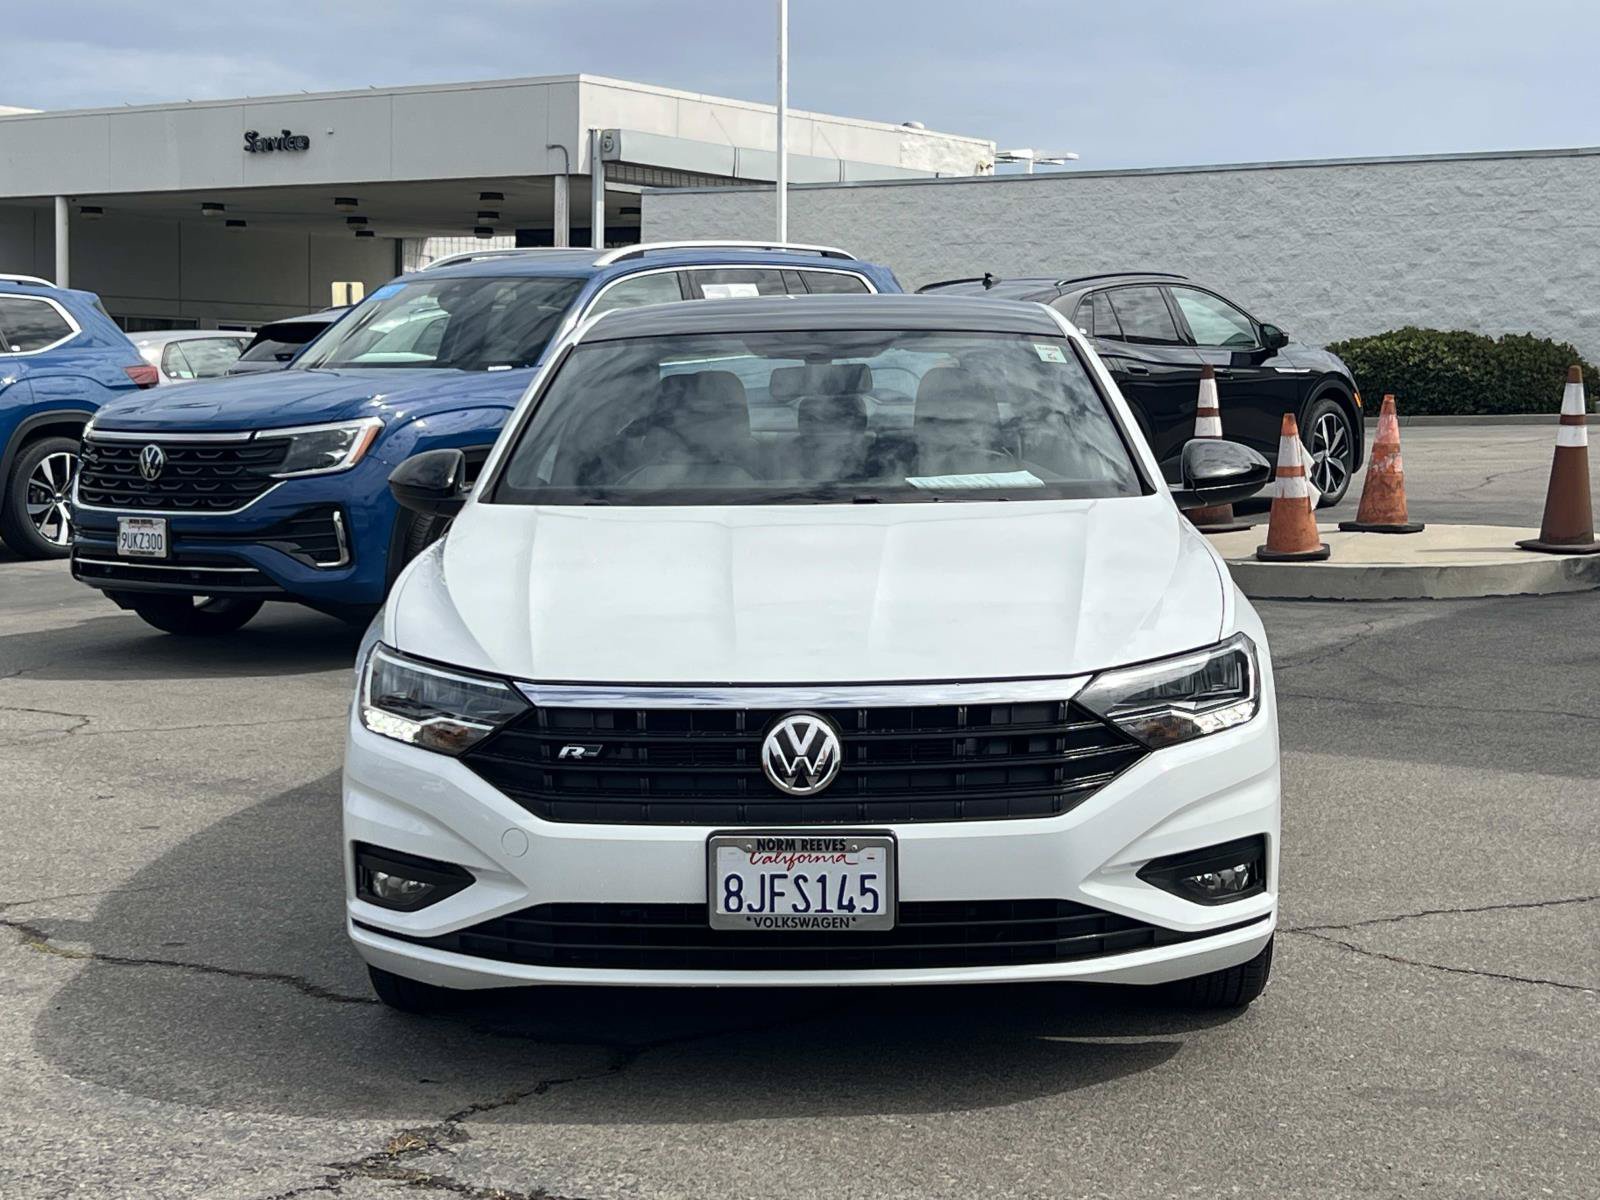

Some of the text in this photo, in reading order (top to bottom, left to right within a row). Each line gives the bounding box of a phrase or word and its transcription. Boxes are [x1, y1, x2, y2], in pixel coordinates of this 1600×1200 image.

[243, 129, 309, 153] Service
[121, 532, 163, 550] 9UKZ300
[756, 838, 846, 851] NORM REEVES
[749, 851, 859, 871] California
[724, 873, 879, 914] 8JFS145
[754, 916, 850, 929] VOLKSWAGEN
